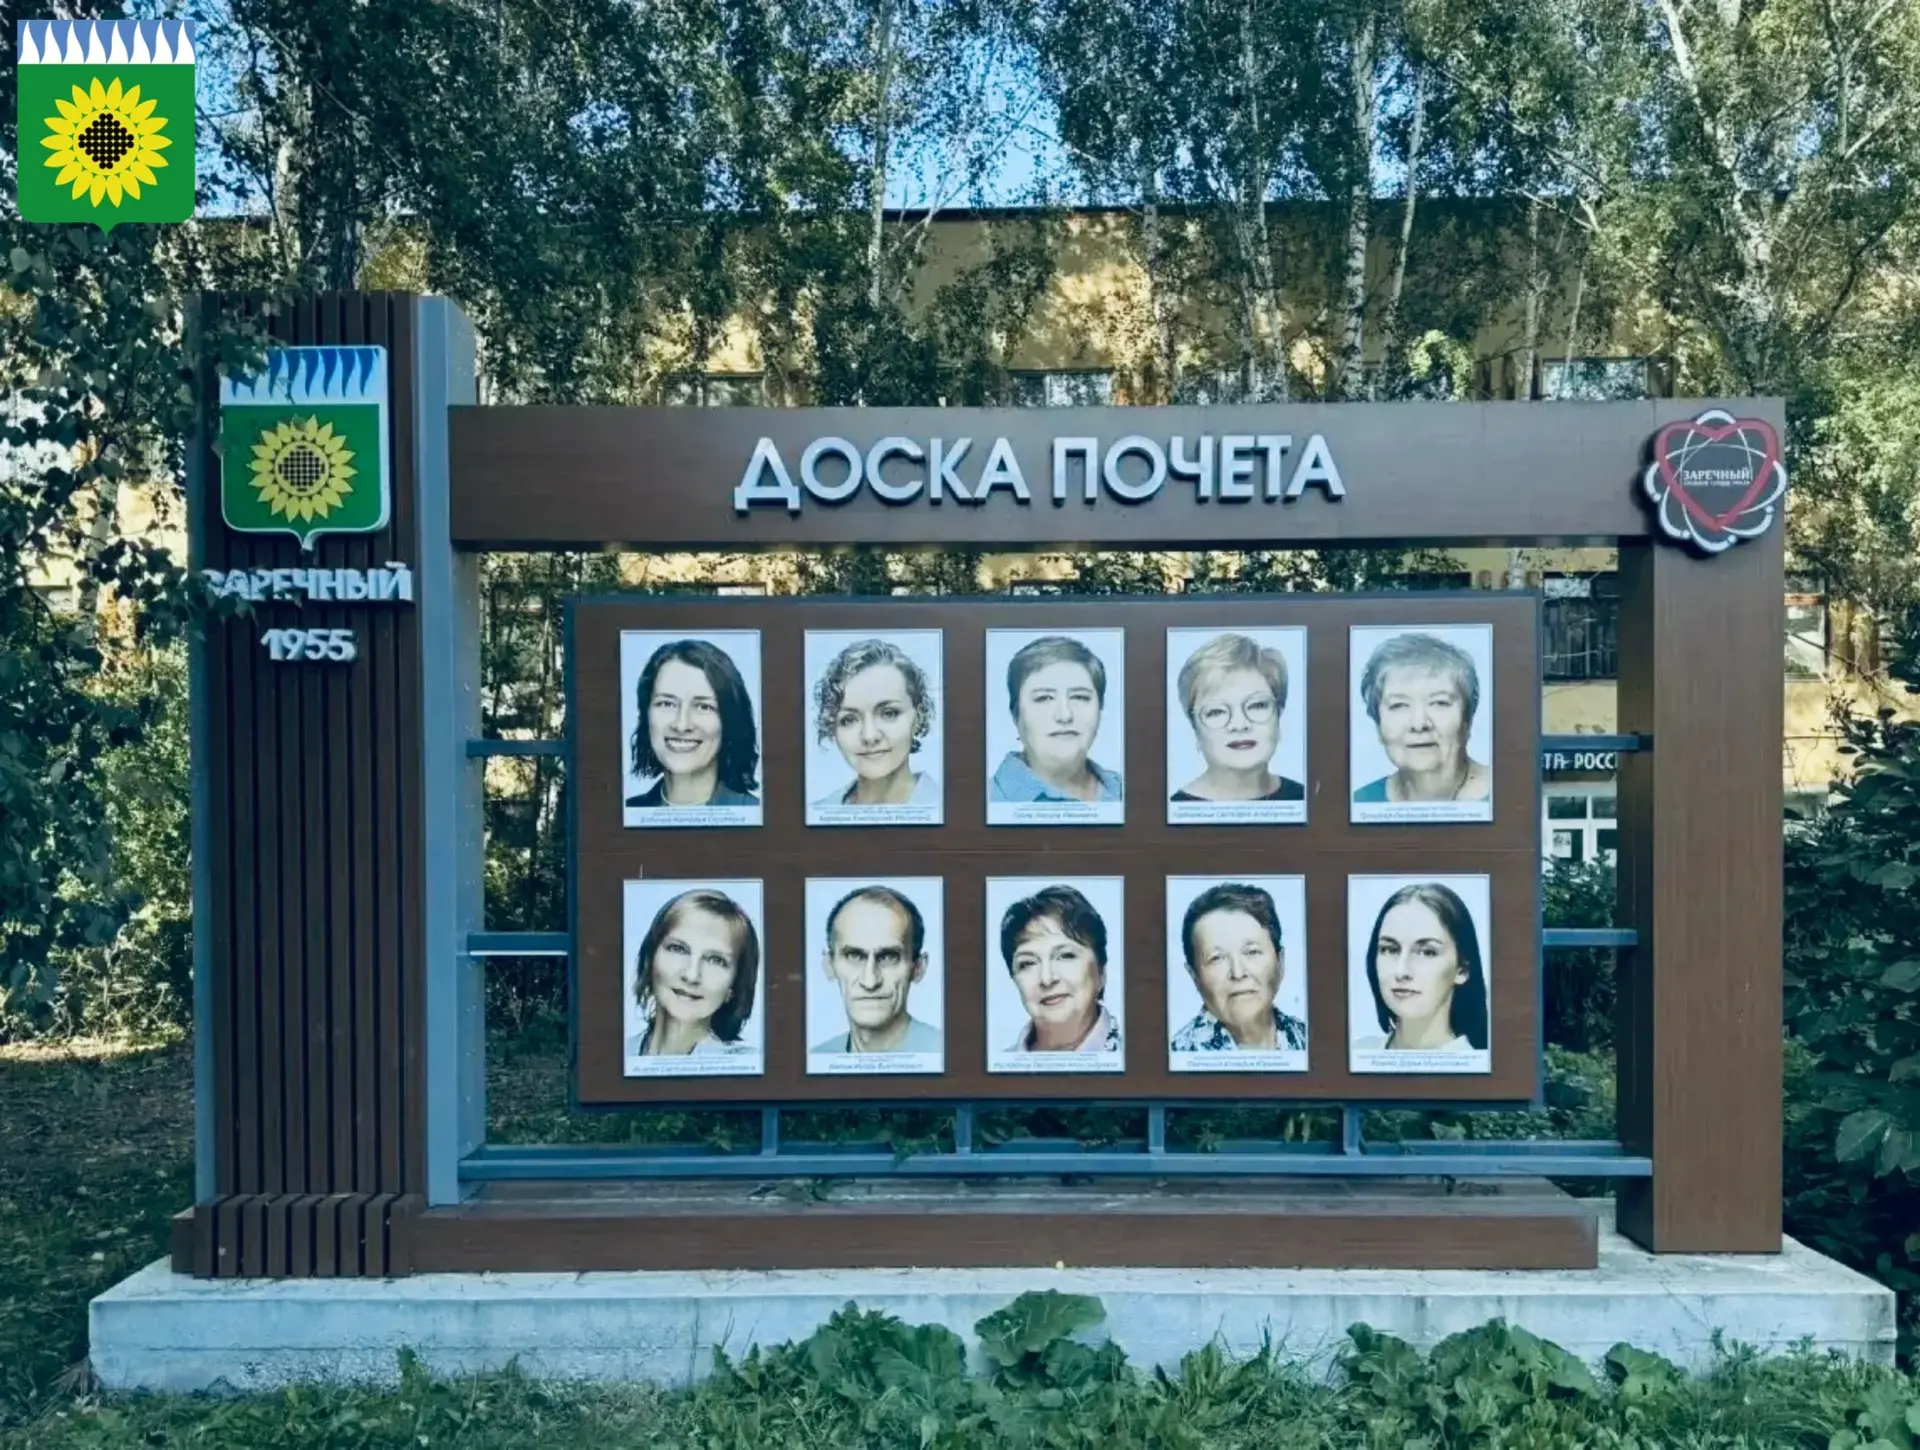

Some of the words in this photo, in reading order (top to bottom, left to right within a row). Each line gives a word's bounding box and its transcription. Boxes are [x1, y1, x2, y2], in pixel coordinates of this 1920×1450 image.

[734, 436, 1030, 512] ДОСКА
[1053, 434, 1347, 501] ПОЧЕТА
[1683, 467, 1750, 480] ЗАРЕЧНЫЙ
[260, 628, 356, 661] 1955
[1541, 752, 1565, 770] ТА
[1574, 752, 1617, 770] РОСС
